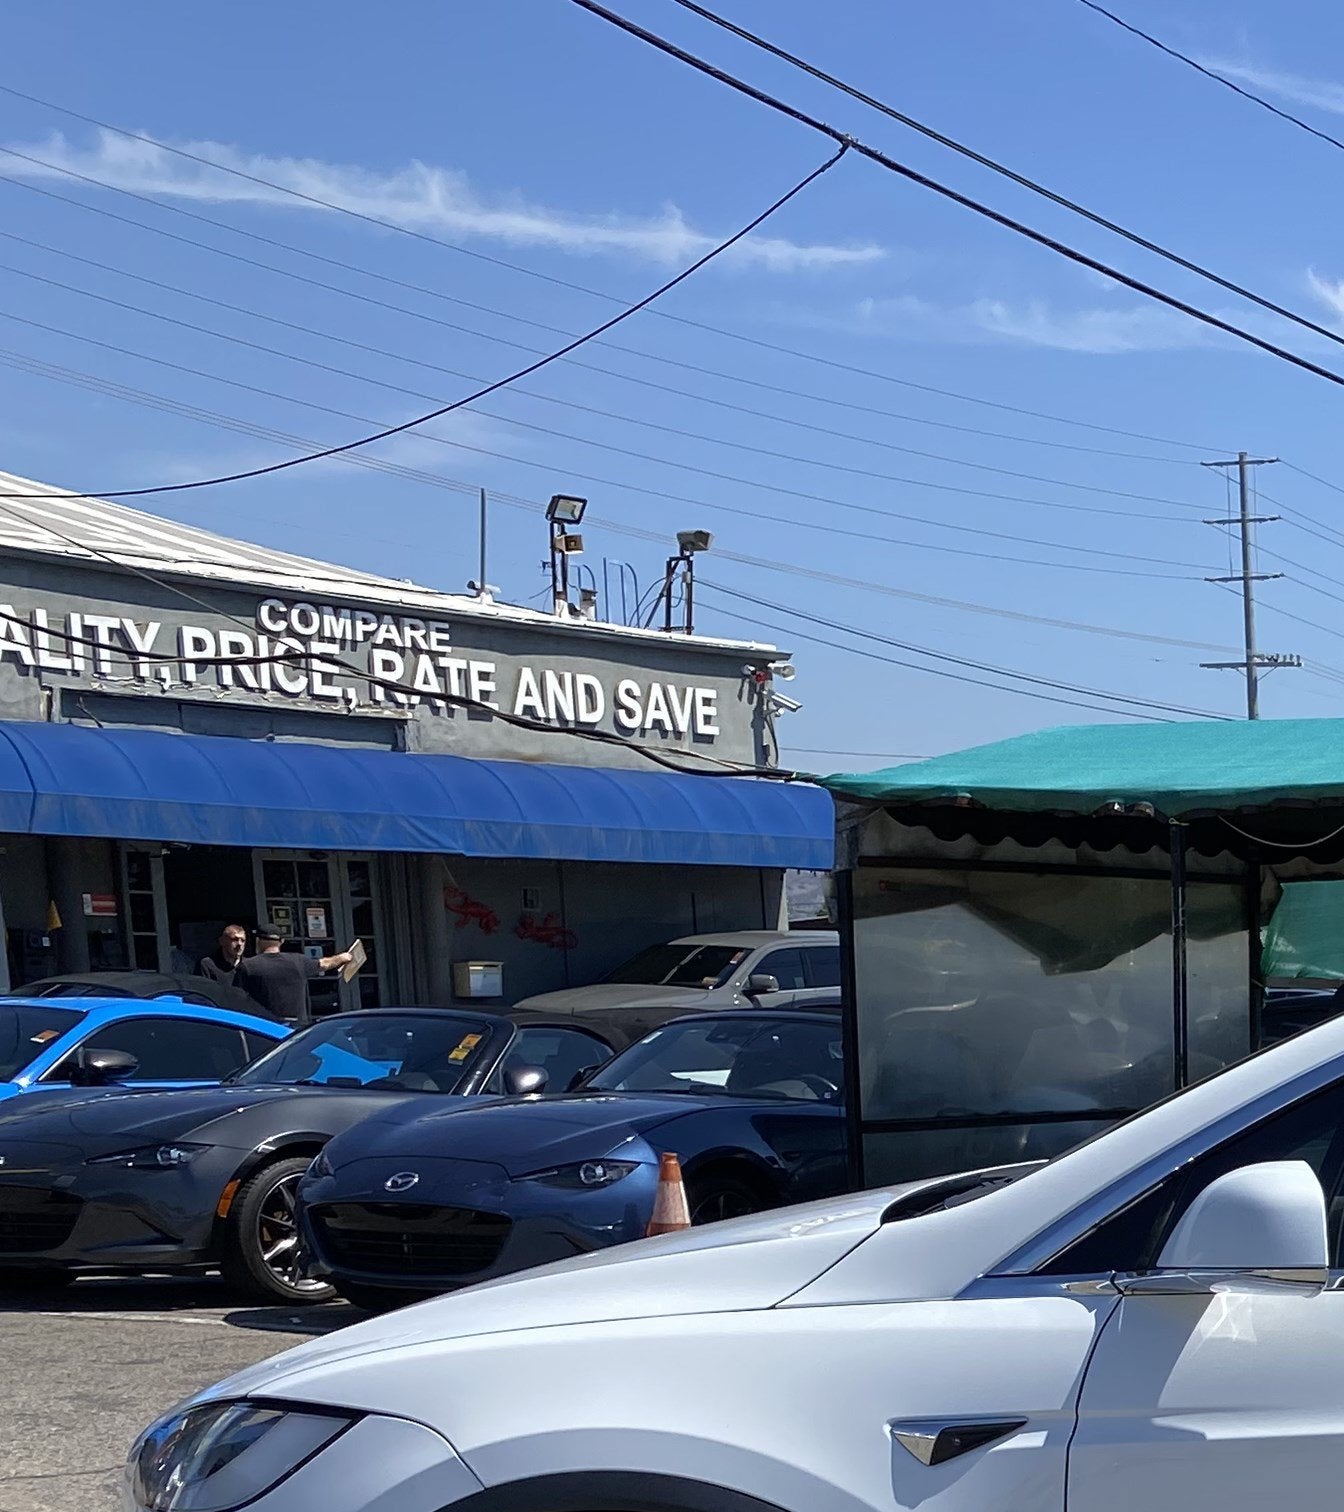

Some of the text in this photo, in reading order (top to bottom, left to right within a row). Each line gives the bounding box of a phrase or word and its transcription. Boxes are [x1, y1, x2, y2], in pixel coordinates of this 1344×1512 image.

[258, 599, 452, 653] COMPARE
[181, 626, 356, 709] PRICE,
[372, 648, 500, 712] RATE
[514, 666, 605, 723] AND
[616, 679, 720, 736] SAVE
